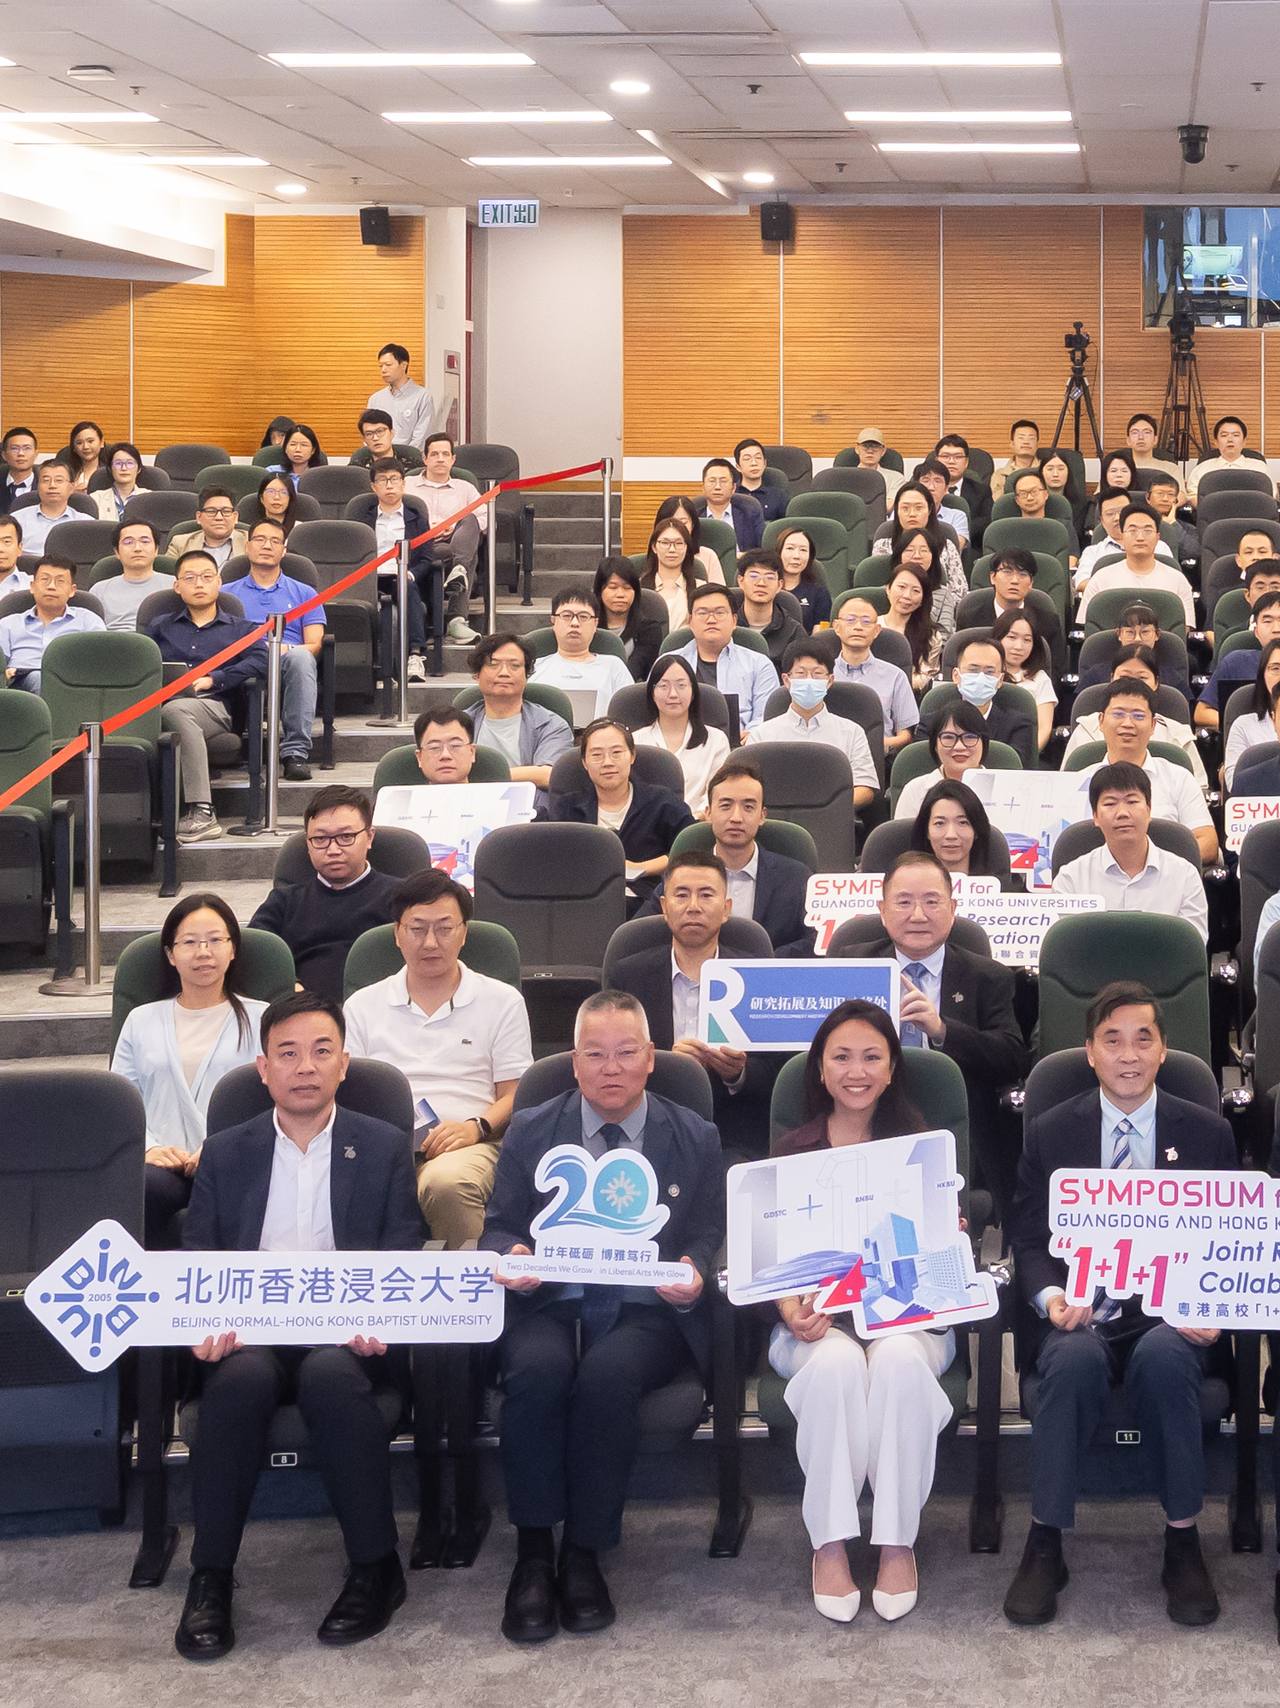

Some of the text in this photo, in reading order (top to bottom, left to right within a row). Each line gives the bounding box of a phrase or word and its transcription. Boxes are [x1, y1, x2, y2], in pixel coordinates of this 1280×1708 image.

[482, 204, 512, 223] EXIT
[514, 204, 537, 223] 出口
[970, 882, 994, 894] for
[969, 898, 1004, 907] KONG
[1008, 898, 1099, 909] UNIVERSITIES
[1059, 1178, 1264, 1208] SYMPOSIUM
[1057, 1213, 1169, 1229] GUANGDONG
[1176, 1214, 1212, 1229] AND
[1219, 1216, 1268, 1231] HONG
[601, 1248, 652, 1263] 博雅笃行
[1202, 1240, 1264, 1264] Joint
[507, 1262, 522, 1271] Two
[523, 1263, 557, 1273] Decades
[558, 1265, 571, 1273] We
[572, 1266, 593, 1274] Grow
[608, 1268, 636, 1276] Liberal
[636, 1269, 651, 1277] Arts
[174, 1265, 495, 1305] 北师香港浸会大学
[87, 1293, 112, 1302] 2005
[171, 1313, 493, 1328] BEIJING NORMAL-HONG KONG BAPTIST UNIVERSITY
[1124, 1433, 1133, 1441] 11
[281, 1455, 287, 1464] 8
